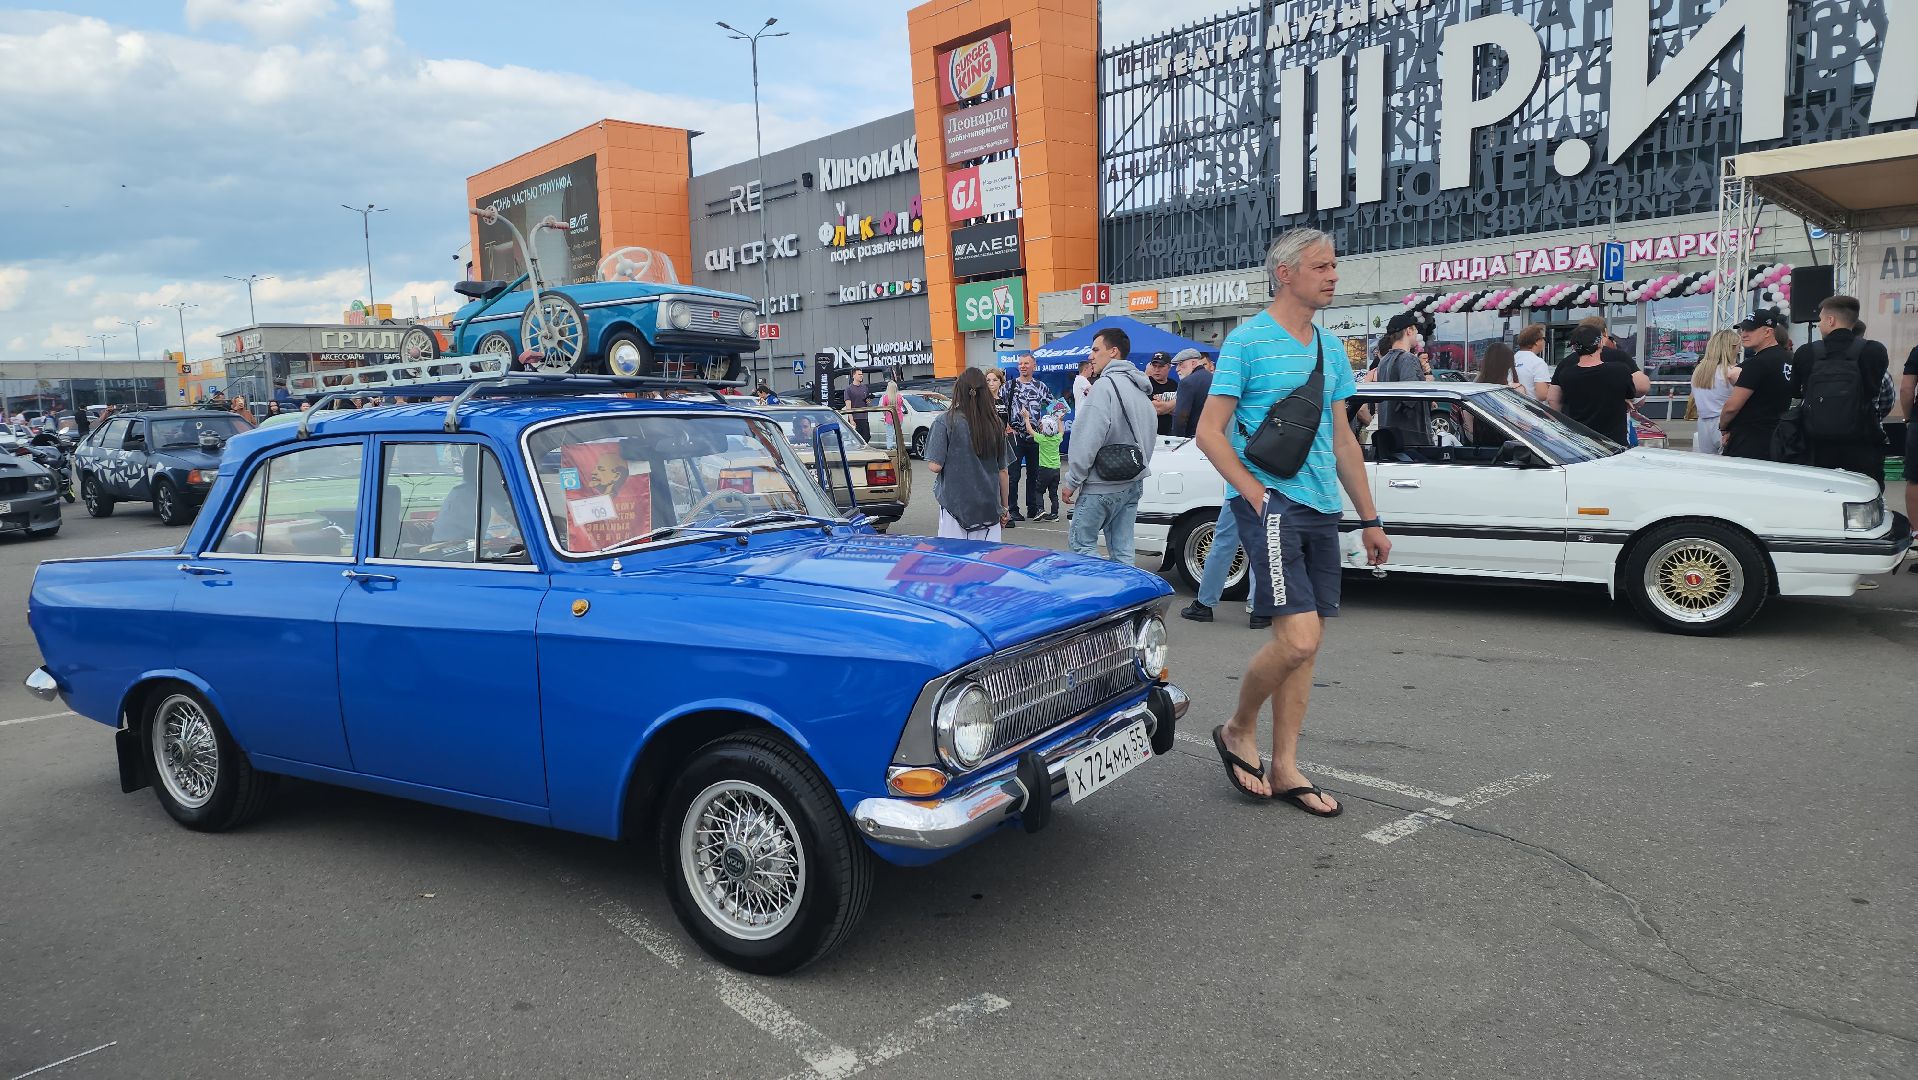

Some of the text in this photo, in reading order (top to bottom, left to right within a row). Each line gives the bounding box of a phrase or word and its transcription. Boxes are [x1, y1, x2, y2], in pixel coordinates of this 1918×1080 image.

[955, 41, 989, 78] BURGER
[1157, 34, 1249, 81] ТЕАТР
[958, 53, 991, 94] KING
[947, 106, 1008, 134] Леонардо
[818, 134, 920, 192] КИНОМАК
[511, 186, 538, 206] ЧАСТЬЮ
[539, 173, 573, 196] ТРИУМФА
[729, 180, 762, 216] RE
[1543, 162, 1713, 211] МУЗЫКА
[830, 245, 857, 265] парк
[1420, 255, 1508, 282] ПАНДА
[1515, 243, 1597, 275] ТАБА
[1609, 247, 1621, 278] P
[1085, 289, 1092, 300] 6
[1100, 288, 1106, 299] 6
[1131, 295, 1154, 306] STIHL
[1170, 280, 1249, 307] ТЕХНИКА
[771, 327, 776, 336] 5
[1000, 316, 1011, 336] P
[822, 343, 870, 369] DNS
[872, 340, 922, 355] ЦИФРОВАЯ И
[1064, 362, 1079, 370] АВТО
[1074, 726, 1144, 795] Х724МА 55
